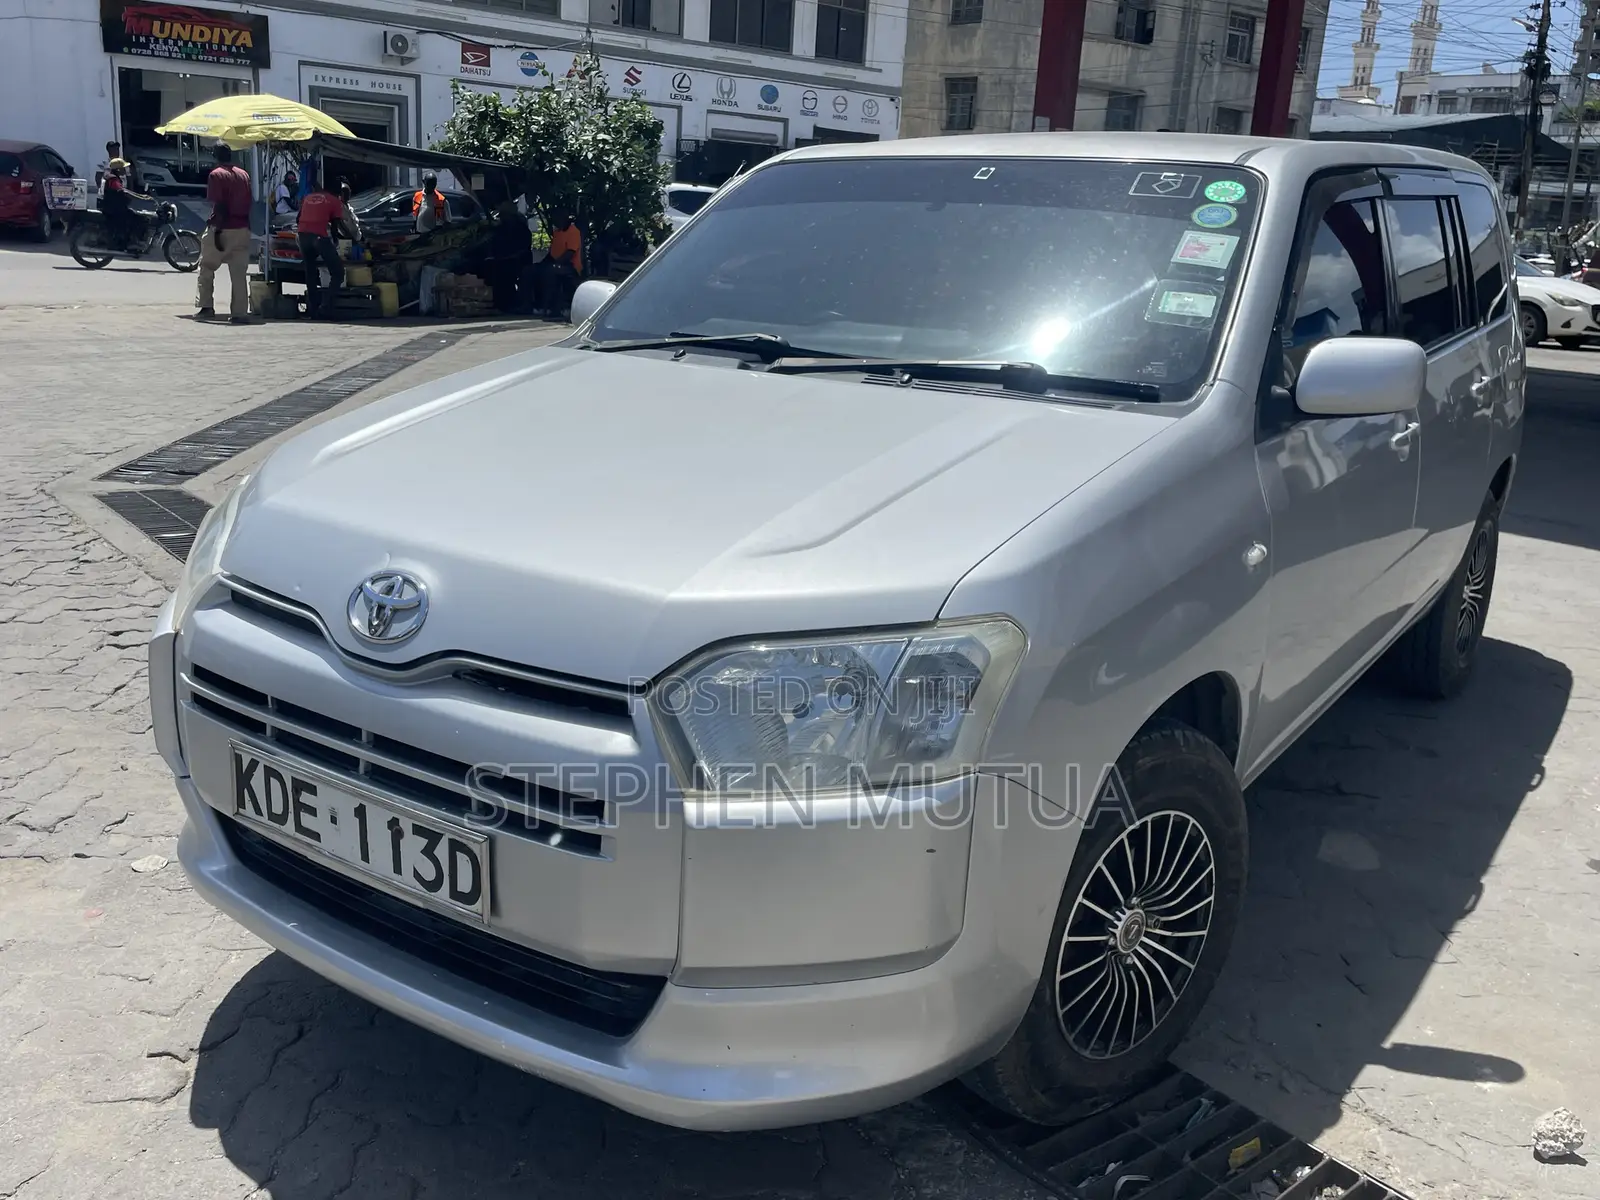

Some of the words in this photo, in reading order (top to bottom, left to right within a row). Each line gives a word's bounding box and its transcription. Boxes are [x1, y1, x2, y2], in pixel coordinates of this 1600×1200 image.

[124, 15, 253, 48] MUNDIYA
[132, 35, 246, 54] INTERNATIONAL
[149, 43, 180, 53] KENYA
[460, 66, 491, 77] DAIHATSU
[314, 74, 360, 86] EXPRESS
[371, 81, 402, 91] HOUSE
[669, 93, 693, 101] LEXUS
[711, 98, 739, 108] HONDA
[757, 103, 782, 113] SUBARU
[235, 752, 322, 843] KDE
[353, 802, 482, 906] 113D
